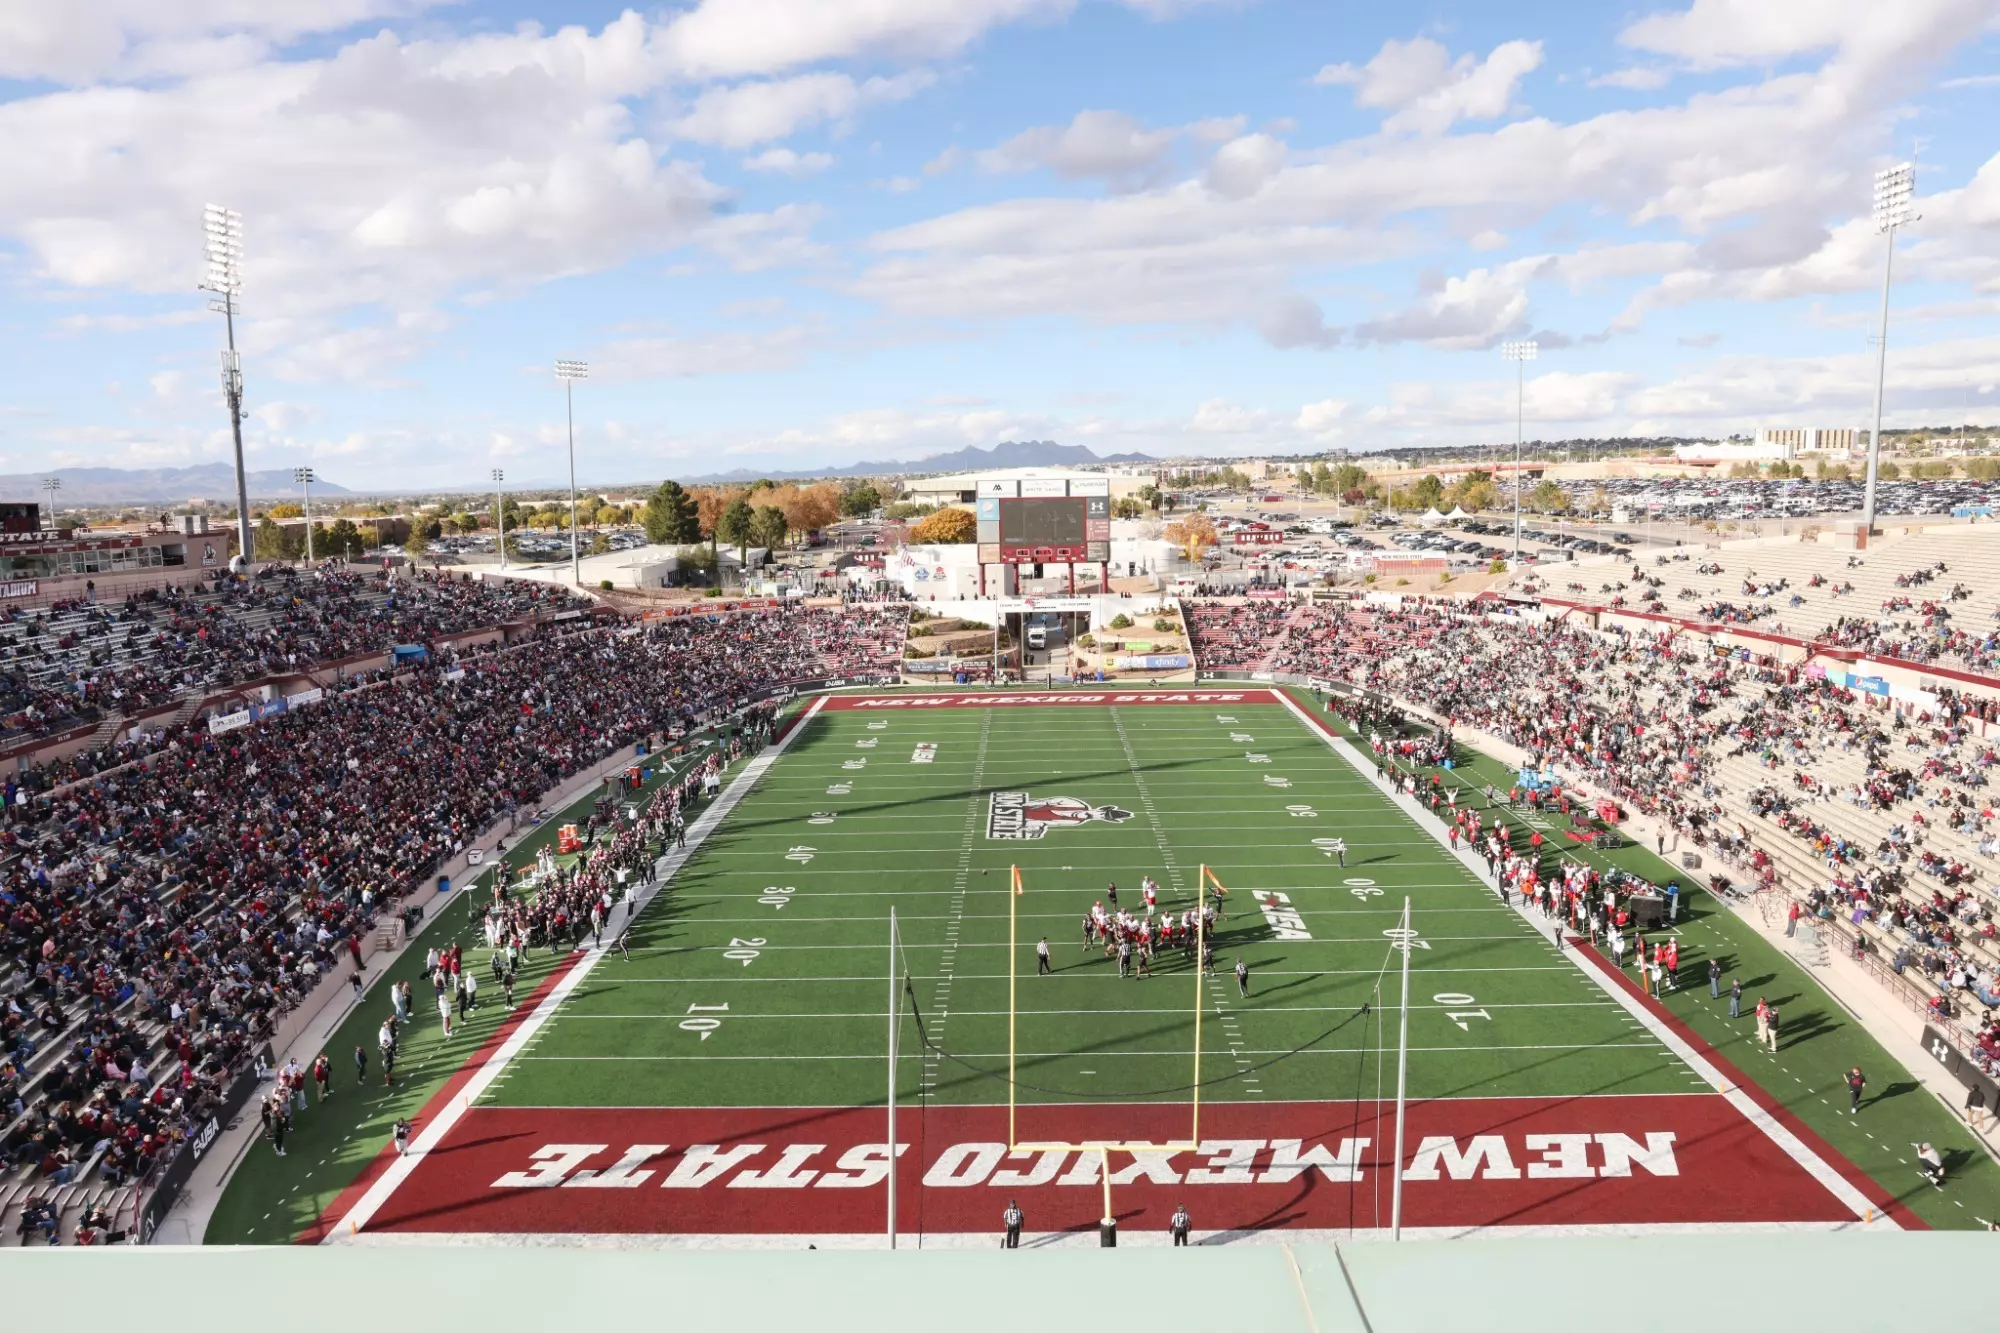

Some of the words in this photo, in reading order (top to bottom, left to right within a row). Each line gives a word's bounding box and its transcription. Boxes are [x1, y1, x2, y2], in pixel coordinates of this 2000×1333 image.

[1155, 658, 1180, 667] xfinity
[1862, 682, 1879, 691] pepsi
[853, 698, 953, 706] NEW
[957, 695, 1106, 705] MEXICO
[1113, 694, 1245, 702] STATE
[807, 812, 839, 825] 50
[1285, 805, 1318, 817] 50
[992, 808, 1023, 839] STATE
[785, 846, 818, 860] 40
[758, 886, 796, 904] 30
[1342, 878, 1385, 896] 30
[723, 937, 767, 959] 20
[1382, 928, 1432, 950] 20
[679, 1002, 730, 1031] 10
[1433, 993, 1492, 1021] 10
[489, 1143, 910, 1188] STATE
[923, 1137, 1371, 1187] MEXICO
[1403, 1132, 1680, 1181] NEW
